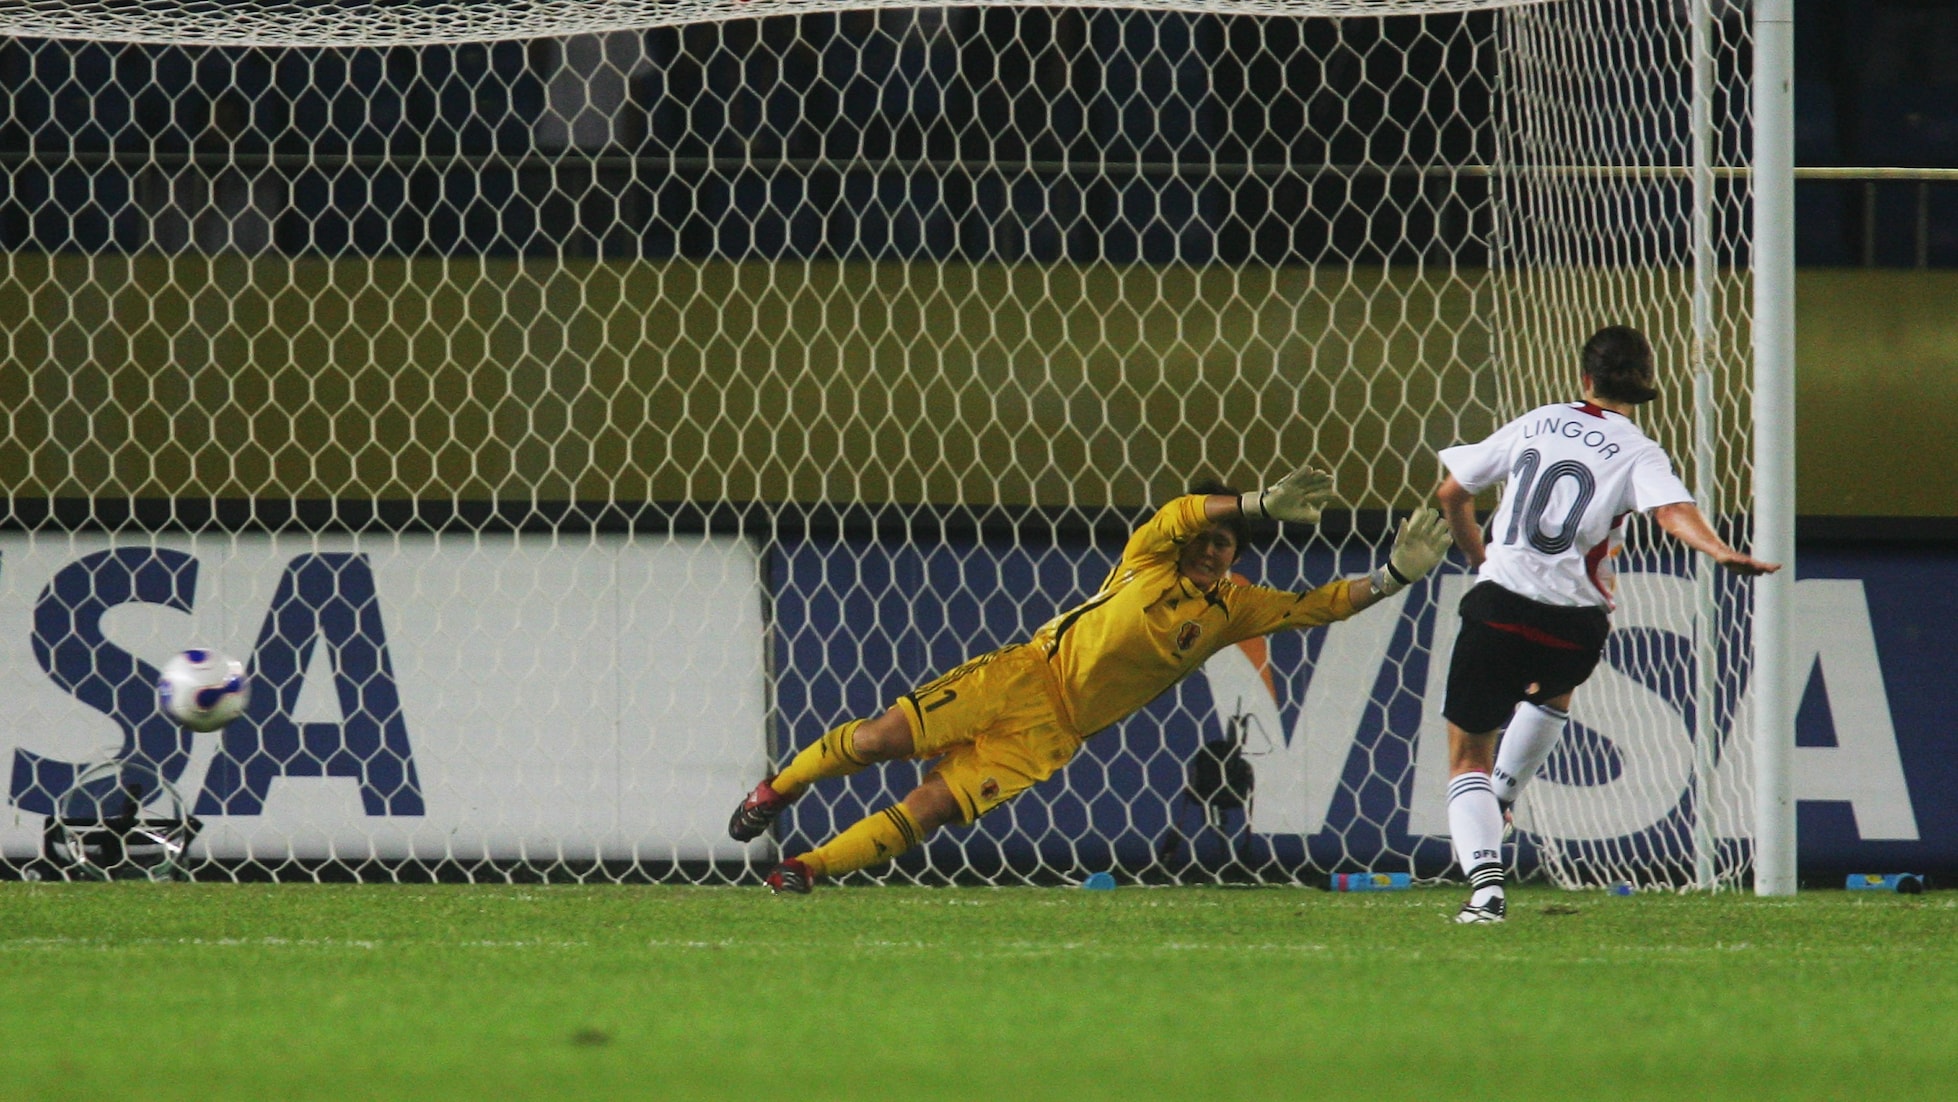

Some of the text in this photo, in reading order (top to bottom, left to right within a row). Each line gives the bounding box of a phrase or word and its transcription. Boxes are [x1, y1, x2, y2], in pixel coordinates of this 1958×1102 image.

[1524, 417, 1620, 460] LINGOR
[1503, 448, 1596, 555] 10
[0, 546, 425, 817] SA
[925, 689, 958, 713] 1
[1473, 849, 1498, 860] DFB
